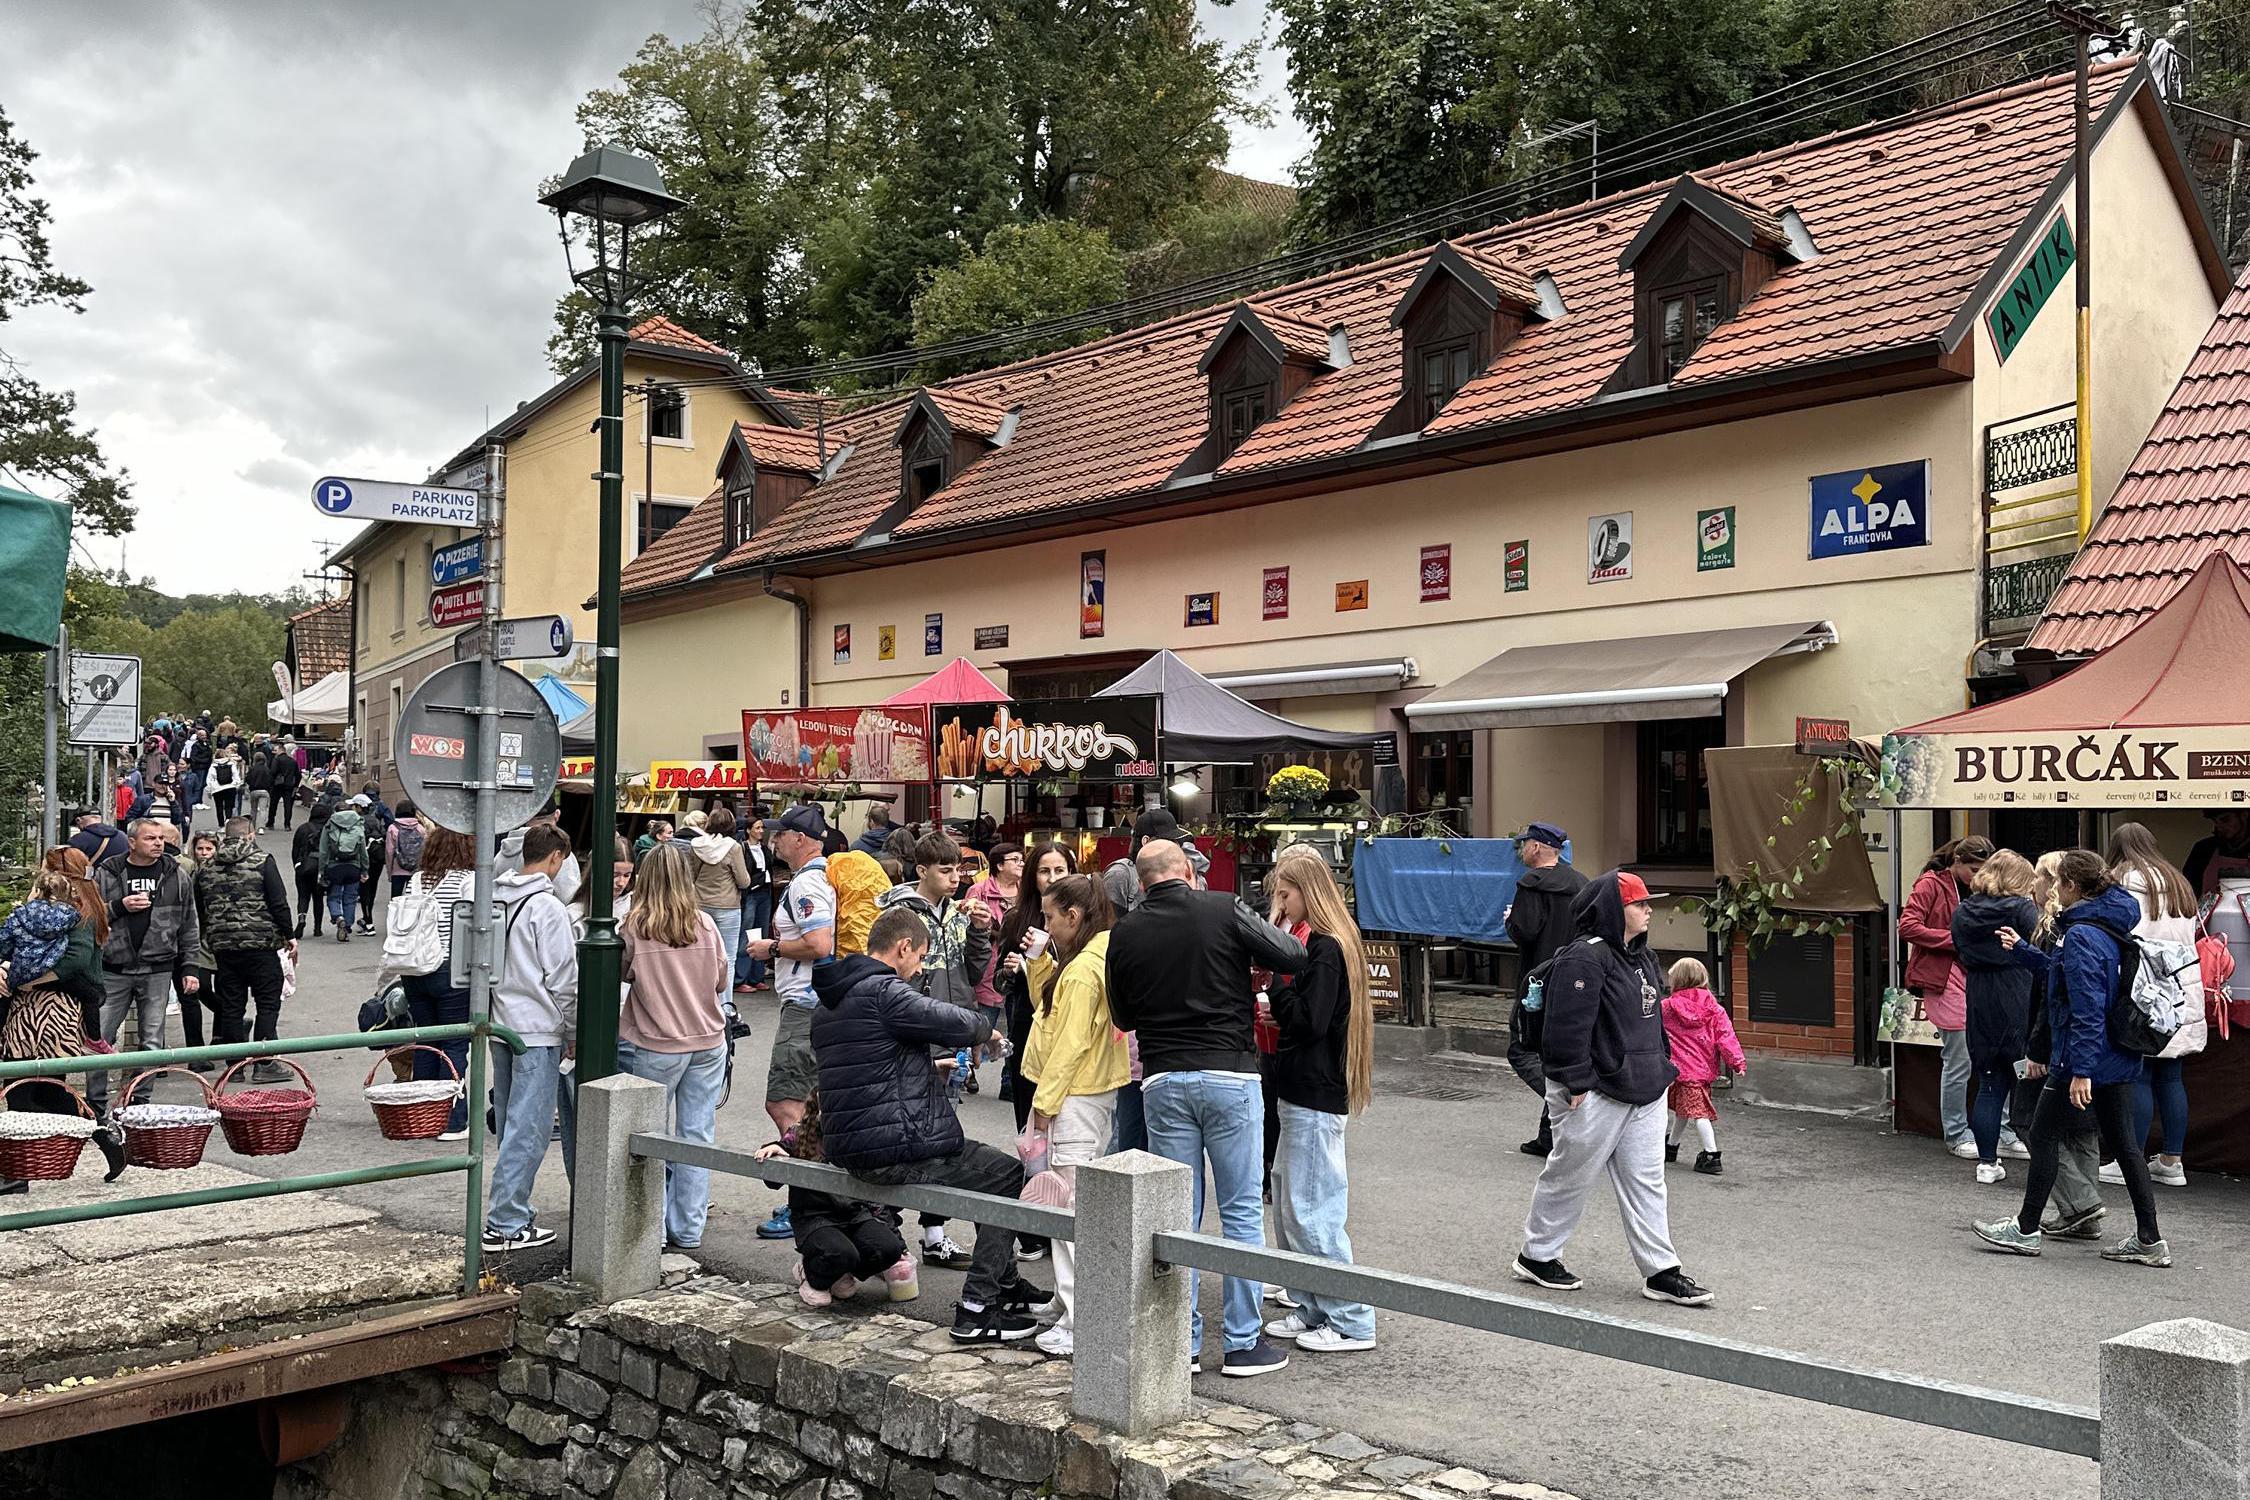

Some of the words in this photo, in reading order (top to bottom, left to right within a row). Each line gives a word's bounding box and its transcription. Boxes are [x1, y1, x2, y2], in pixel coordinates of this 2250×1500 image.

[2000, 223, 2071, 347] ANTIK
[327, 486, 347, 508] P
[412, 490, 475, 507] PARKING
[391, 503, 474, 522] PARKPLATZ
[1820, 499, 1916, 537] ALPA
[1843, 530, 1893, 546] FRANCOVKA
[445, 542, 479, 567] PIZZERIE
[443, 593, 465, 609] HOTEL
[871, 714, 922, 736] POPCORN
[1805, 722, 1849, 742] ANTIQUES
[1954, 734, 2180, 783] BURČÁK
[1114, 760, 1156, 777] nutella
[1363, 942, 1396, 957] ÁLKA
[1367, 963, 1391, 978] VA
